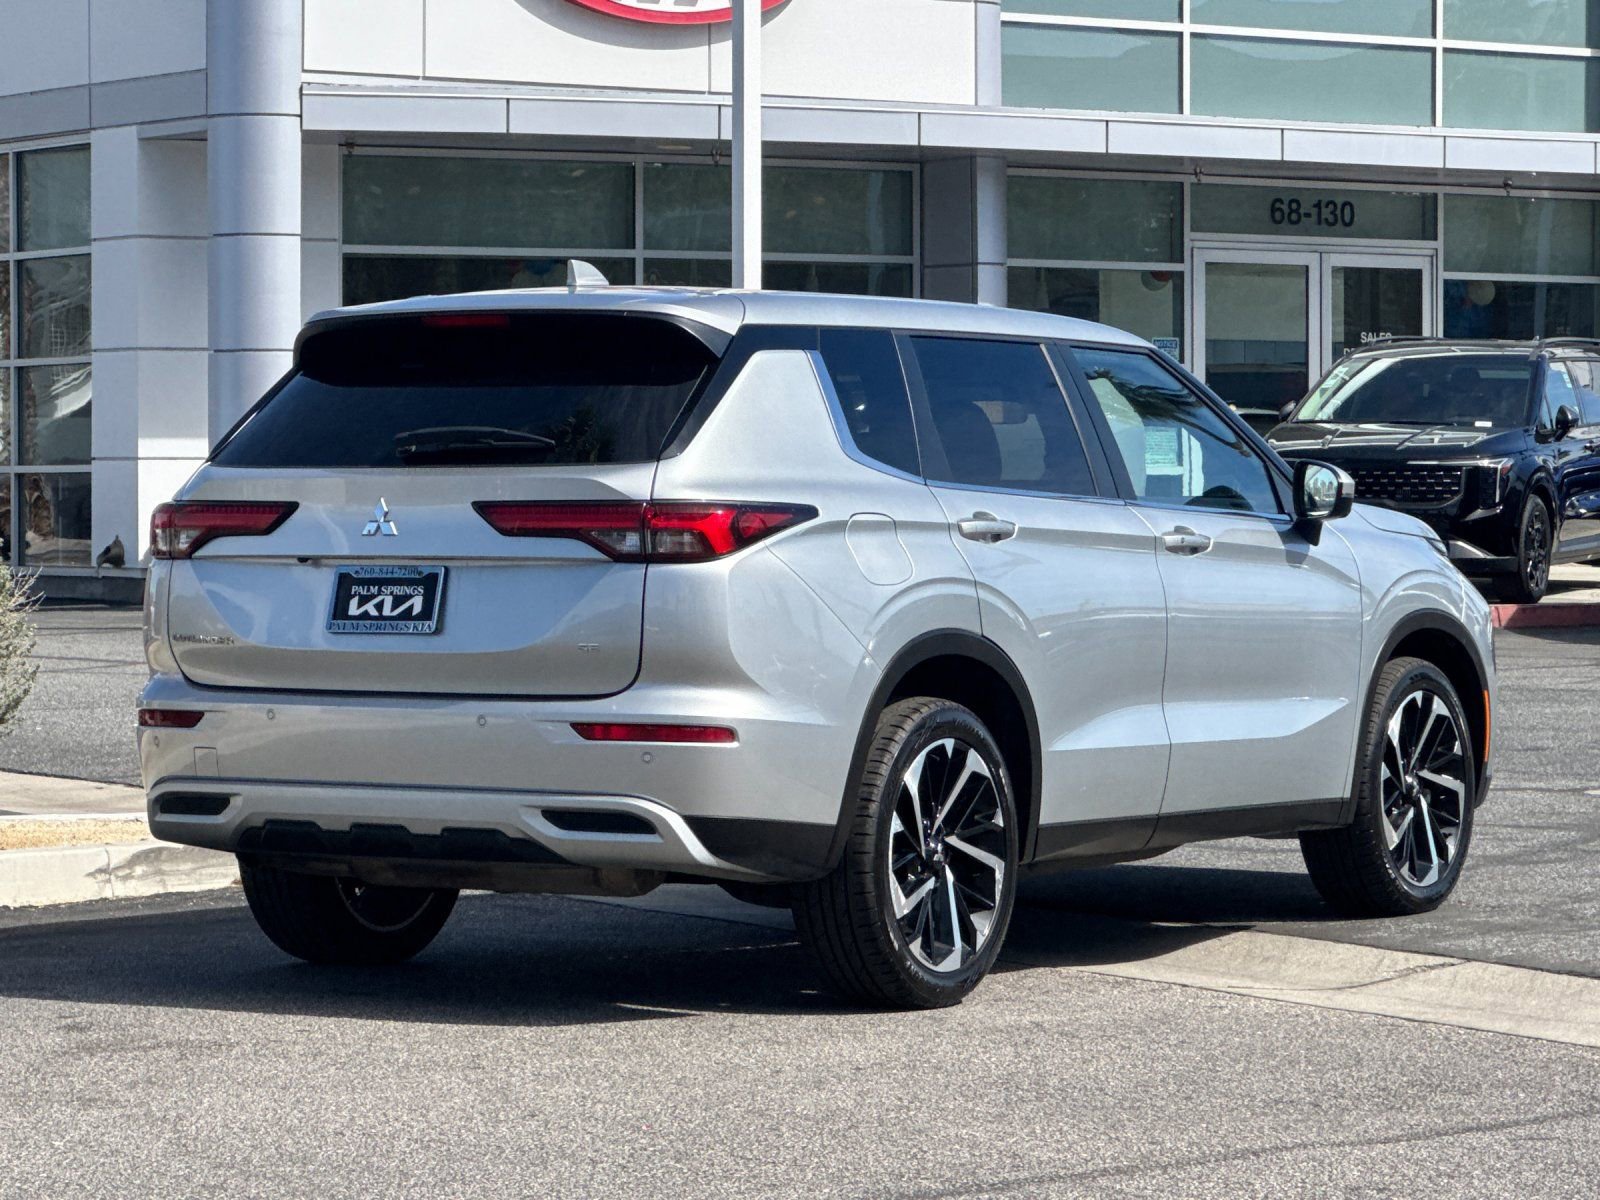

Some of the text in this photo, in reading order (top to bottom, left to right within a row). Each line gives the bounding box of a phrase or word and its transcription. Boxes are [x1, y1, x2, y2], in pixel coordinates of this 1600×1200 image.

[1270, 197, 1355, 227] 68-130
[350, 585, 424, 595] PALM SPRINGS
[347, 595, 423, 616] KIA
[328, 621, 433, 632] PALM SPRINGS KIA
